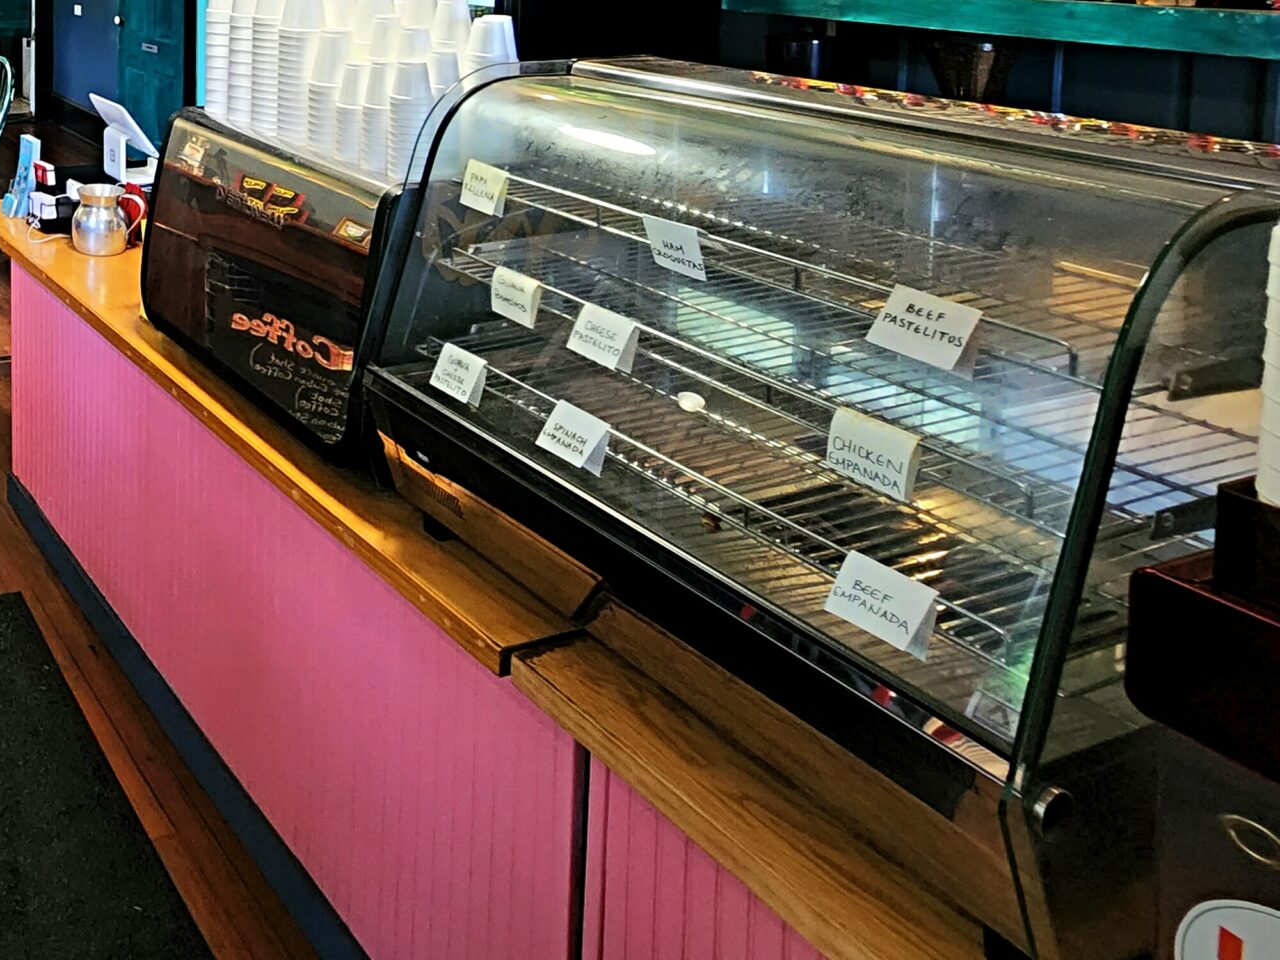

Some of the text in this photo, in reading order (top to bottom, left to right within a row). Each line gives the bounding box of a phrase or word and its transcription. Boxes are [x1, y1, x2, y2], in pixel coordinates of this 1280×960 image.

[662, 240, 685, 255] HAM
[905, 302, 946, 322] BEEF
[572, 329, 621, 357] PASTELITO
[584, 320, 618, 342] CHEESE
[883, 311, 963, 348] PASTELITOS
[542, 429, 584, 457] EMPANADA
[553, 423, 588, 446] SPINACH
[832, 435, 904, 475] CHICKEN
[828, 450, 901, 495] EMPANADA
[852, 578, 894, 604] BEEF
[833, 585, 910, 635] EMPANADA
